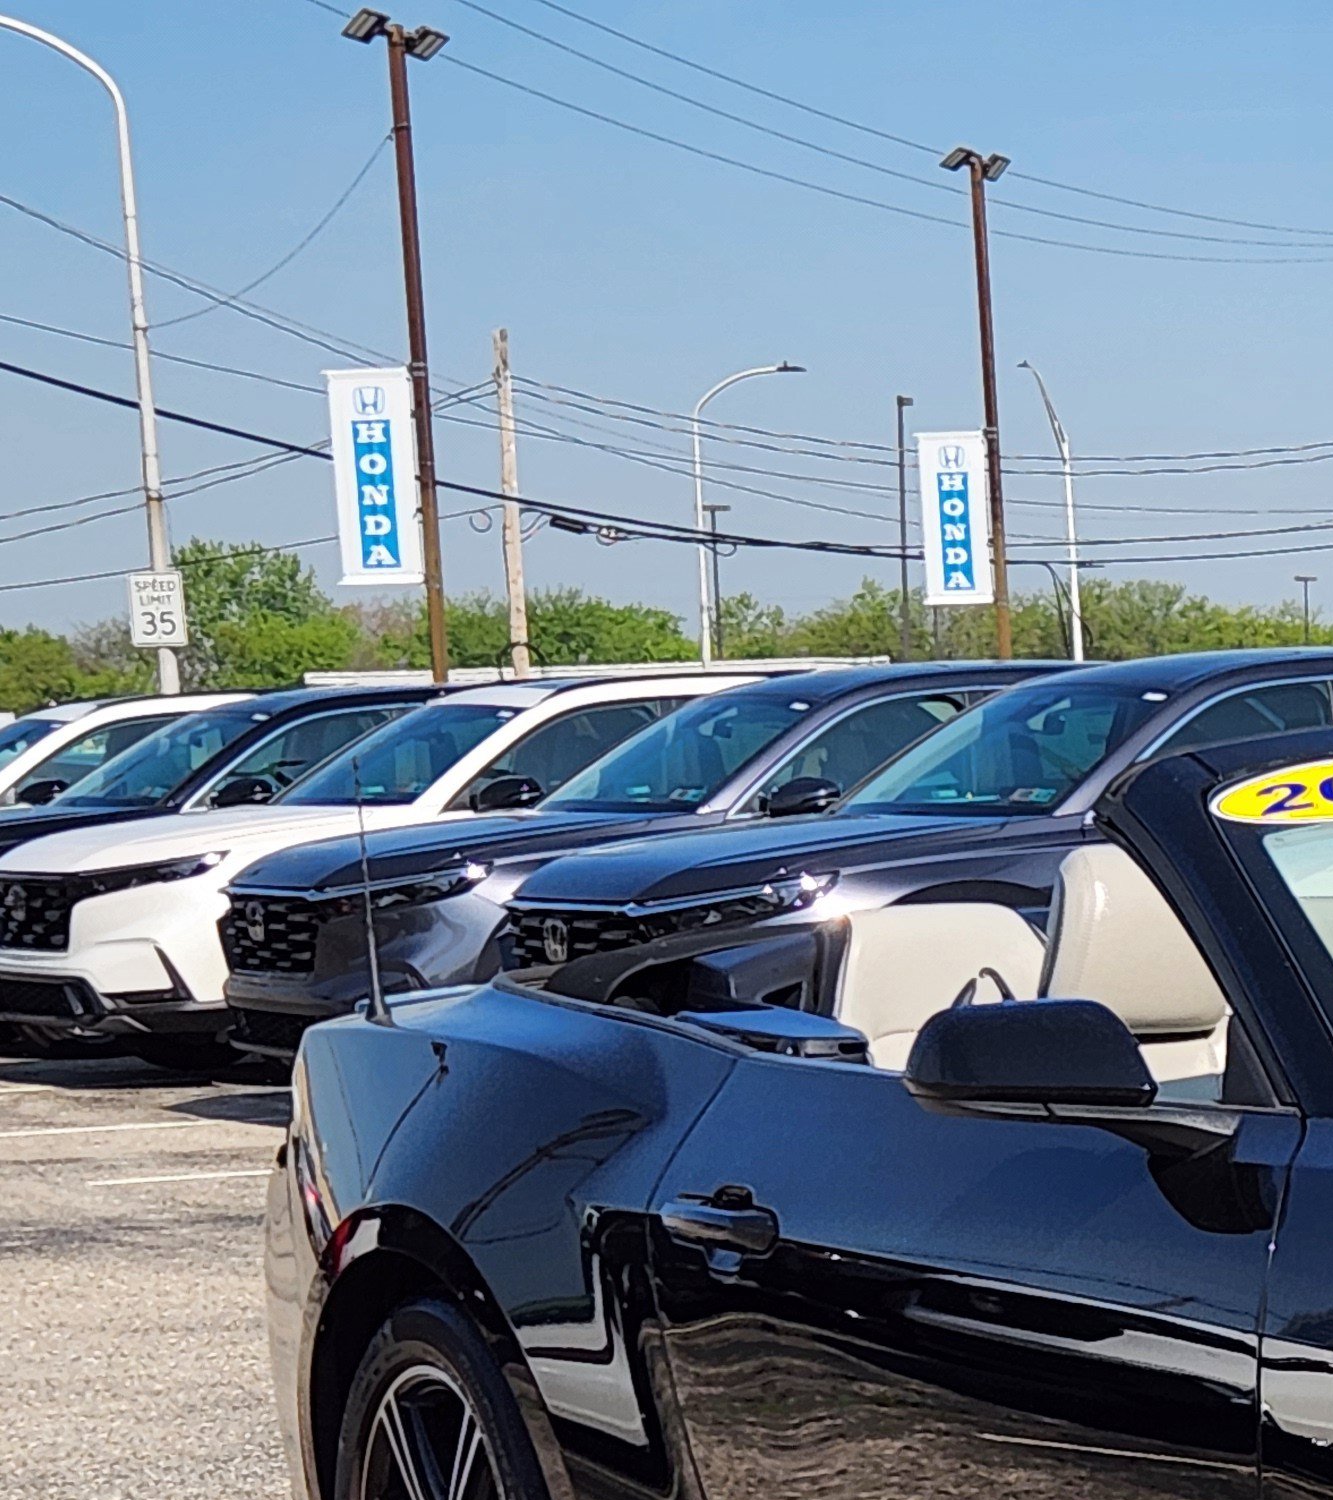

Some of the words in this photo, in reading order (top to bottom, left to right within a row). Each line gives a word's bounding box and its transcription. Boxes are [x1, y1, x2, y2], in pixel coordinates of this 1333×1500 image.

[356, 422, 397, 565] HONDA
[939, 473, 972, 588] HONDA
[134, 579, 176, 592] SPEED
[139, 595, 172, 606] LIMIT
[140, 610, 177, 636] 35
